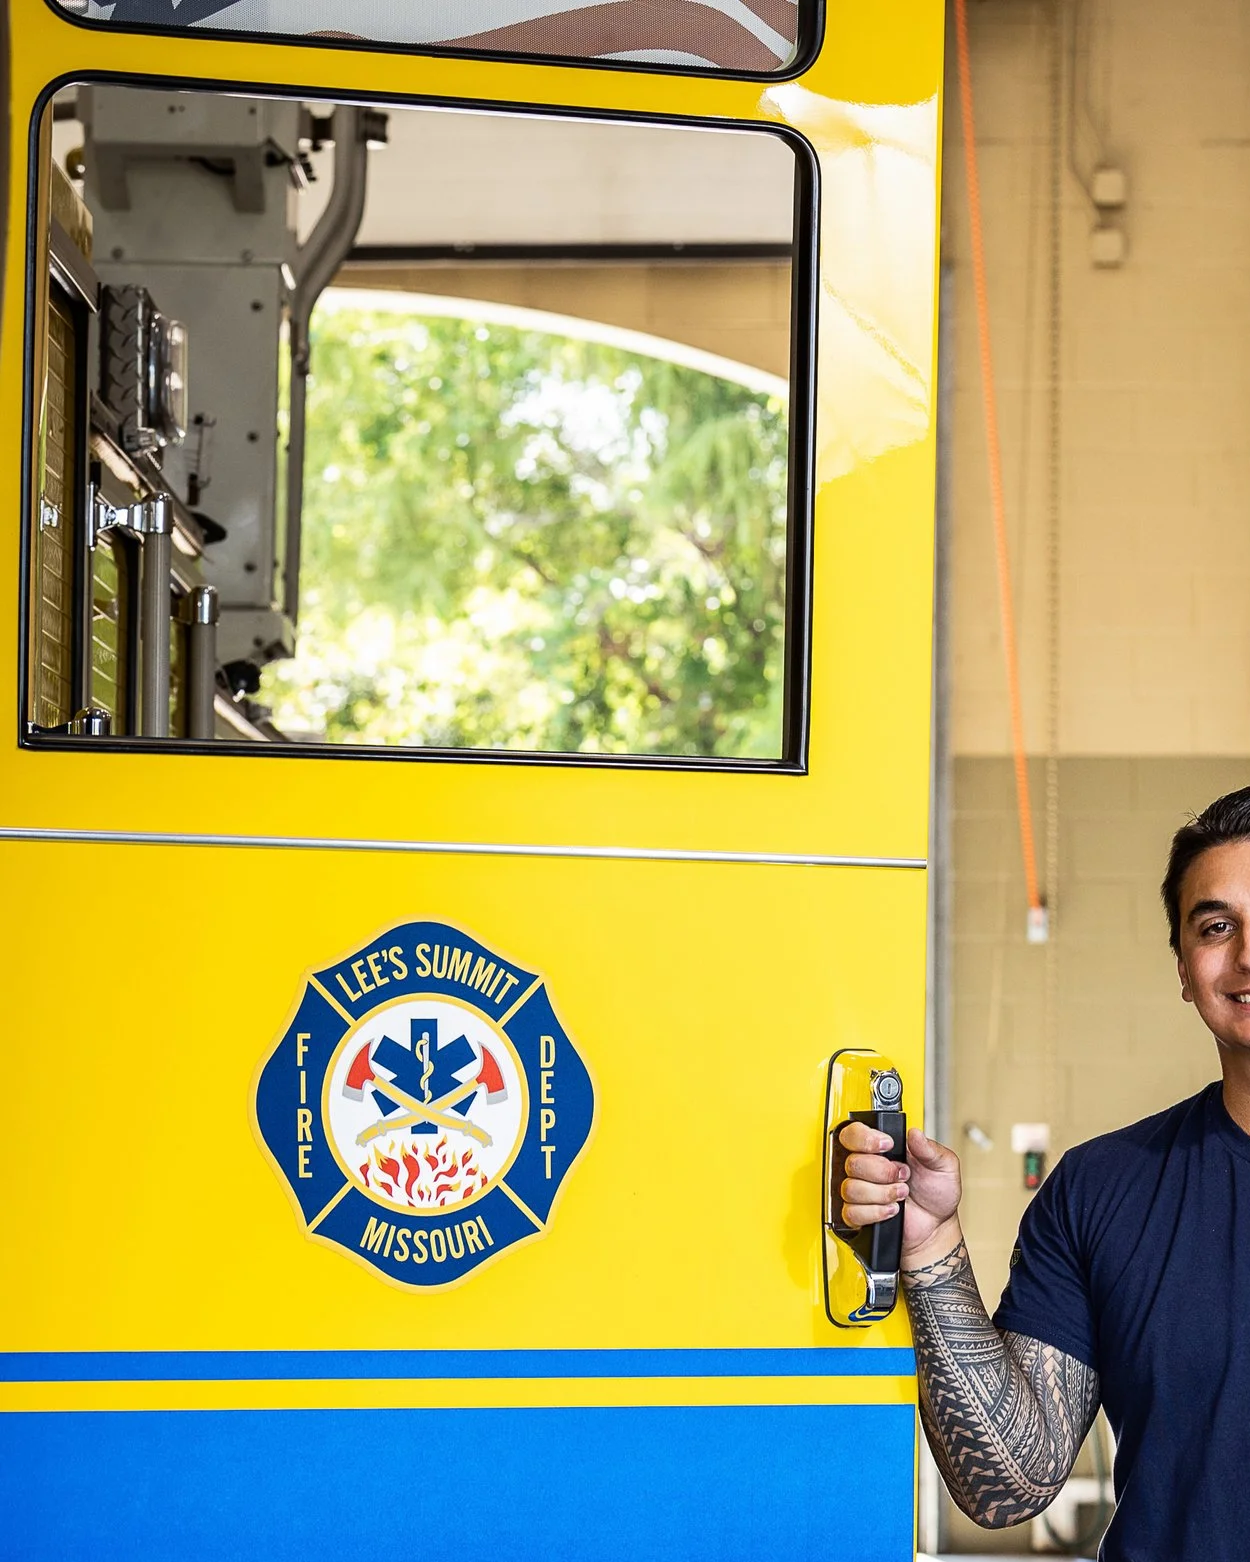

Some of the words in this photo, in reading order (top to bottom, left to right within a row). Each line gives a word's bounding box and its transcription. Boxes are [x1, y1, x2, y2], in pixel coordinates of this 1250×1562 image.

[335, 945, 409, 1003] LEE'S
[415, 943, 520, 1005] SUMMIT
[296, 1032, 313, 1179] FIRE
[539, 1035, 556, 1180] DEPT
[359, 1215, 494, 1264] MISSOURI
